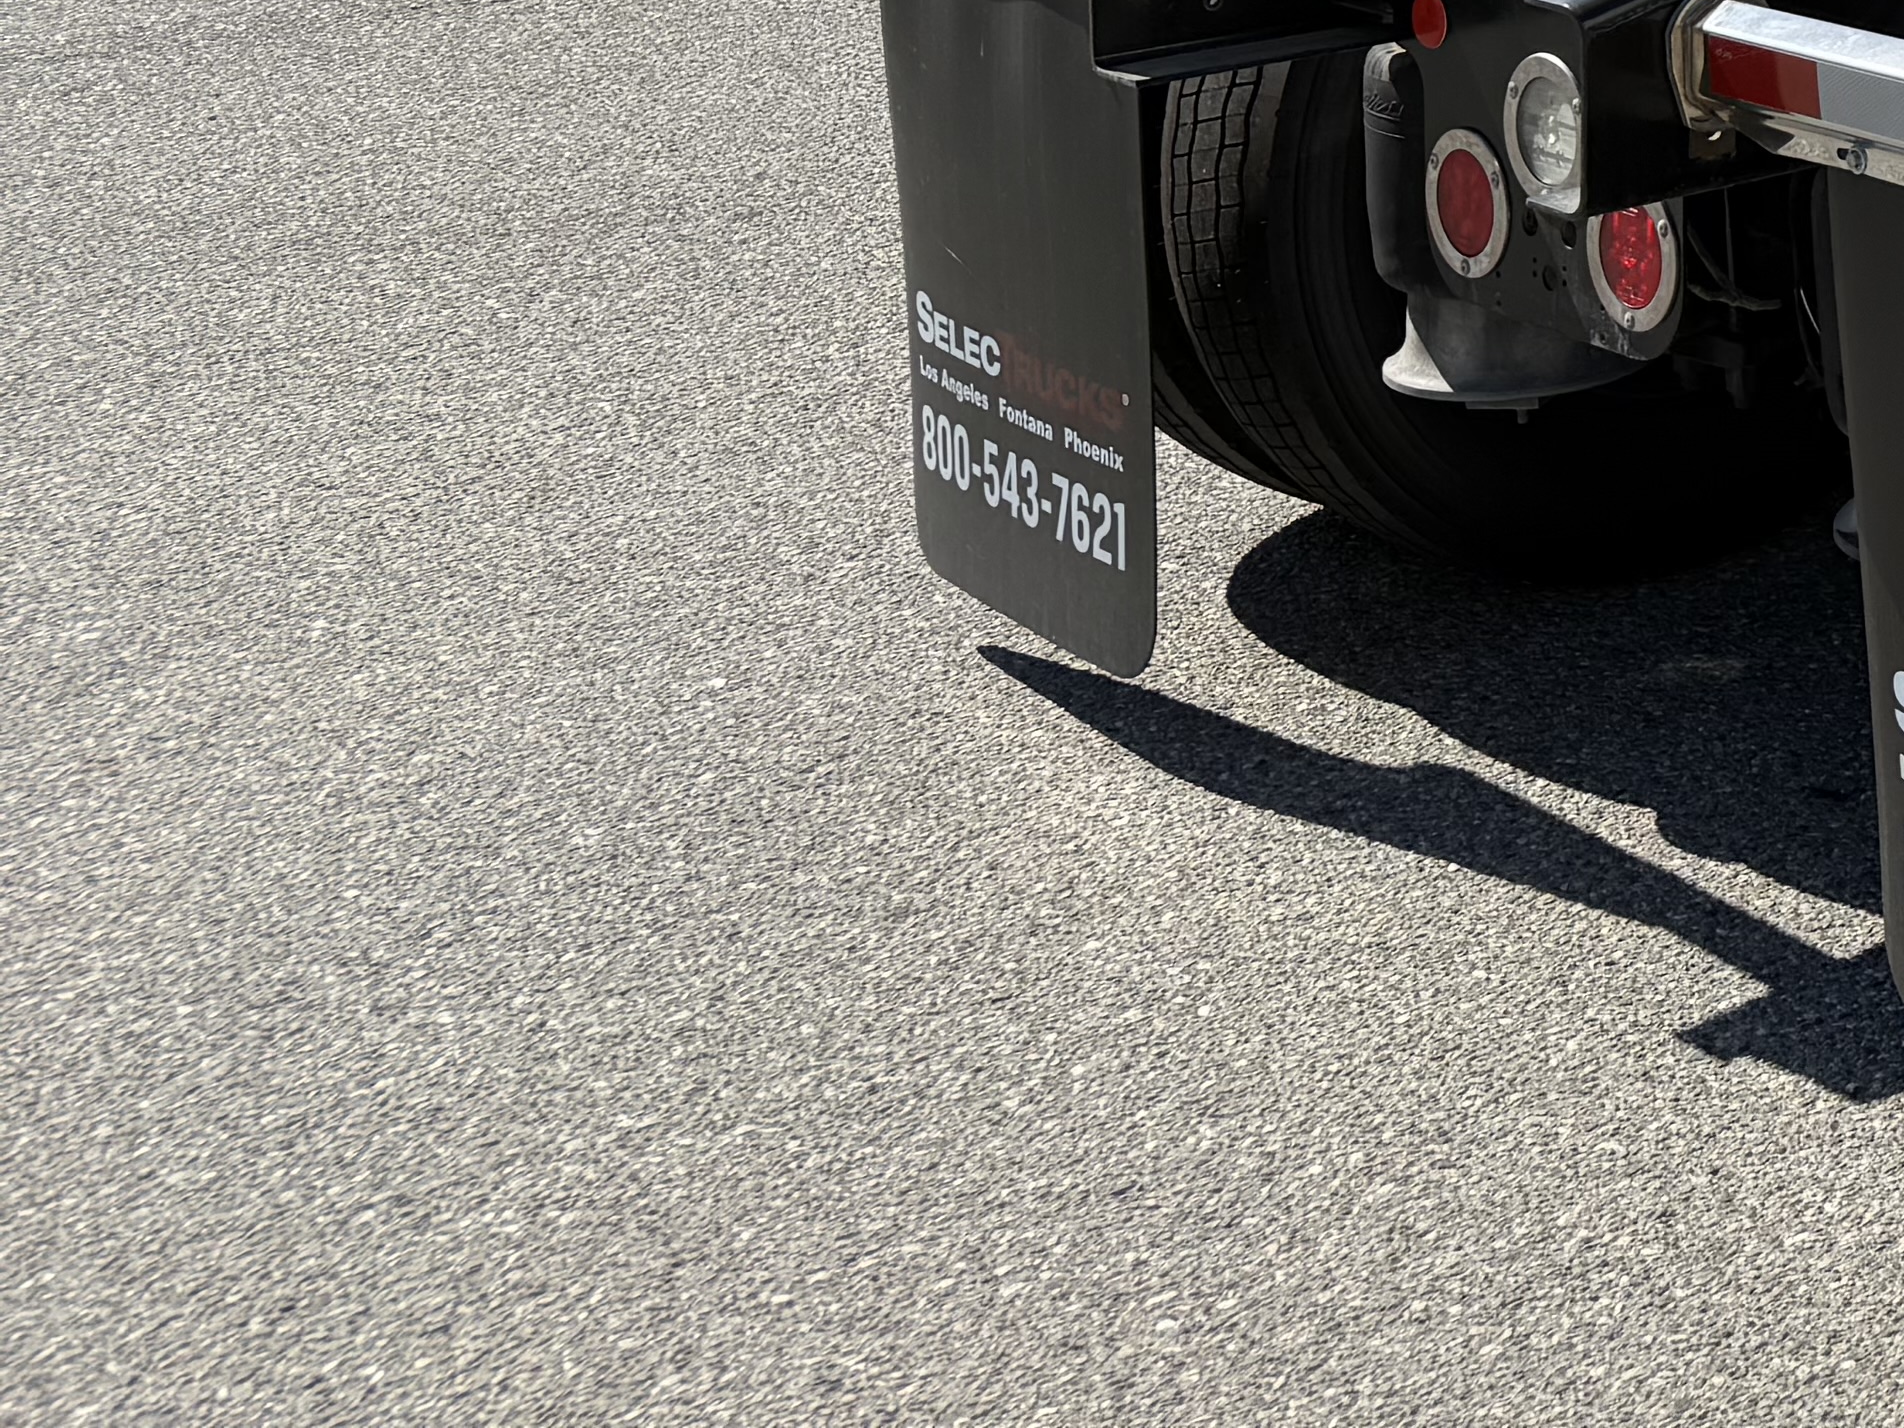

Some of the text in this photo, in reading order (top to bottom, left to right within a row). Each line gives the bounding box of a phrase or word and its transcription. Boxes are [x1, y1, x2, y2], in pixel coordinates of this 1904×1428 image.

[919, 354, 1125, 473] Los Angeles Fontana Phoenix
[921, 404, 1127, 572] 800-543-7621
